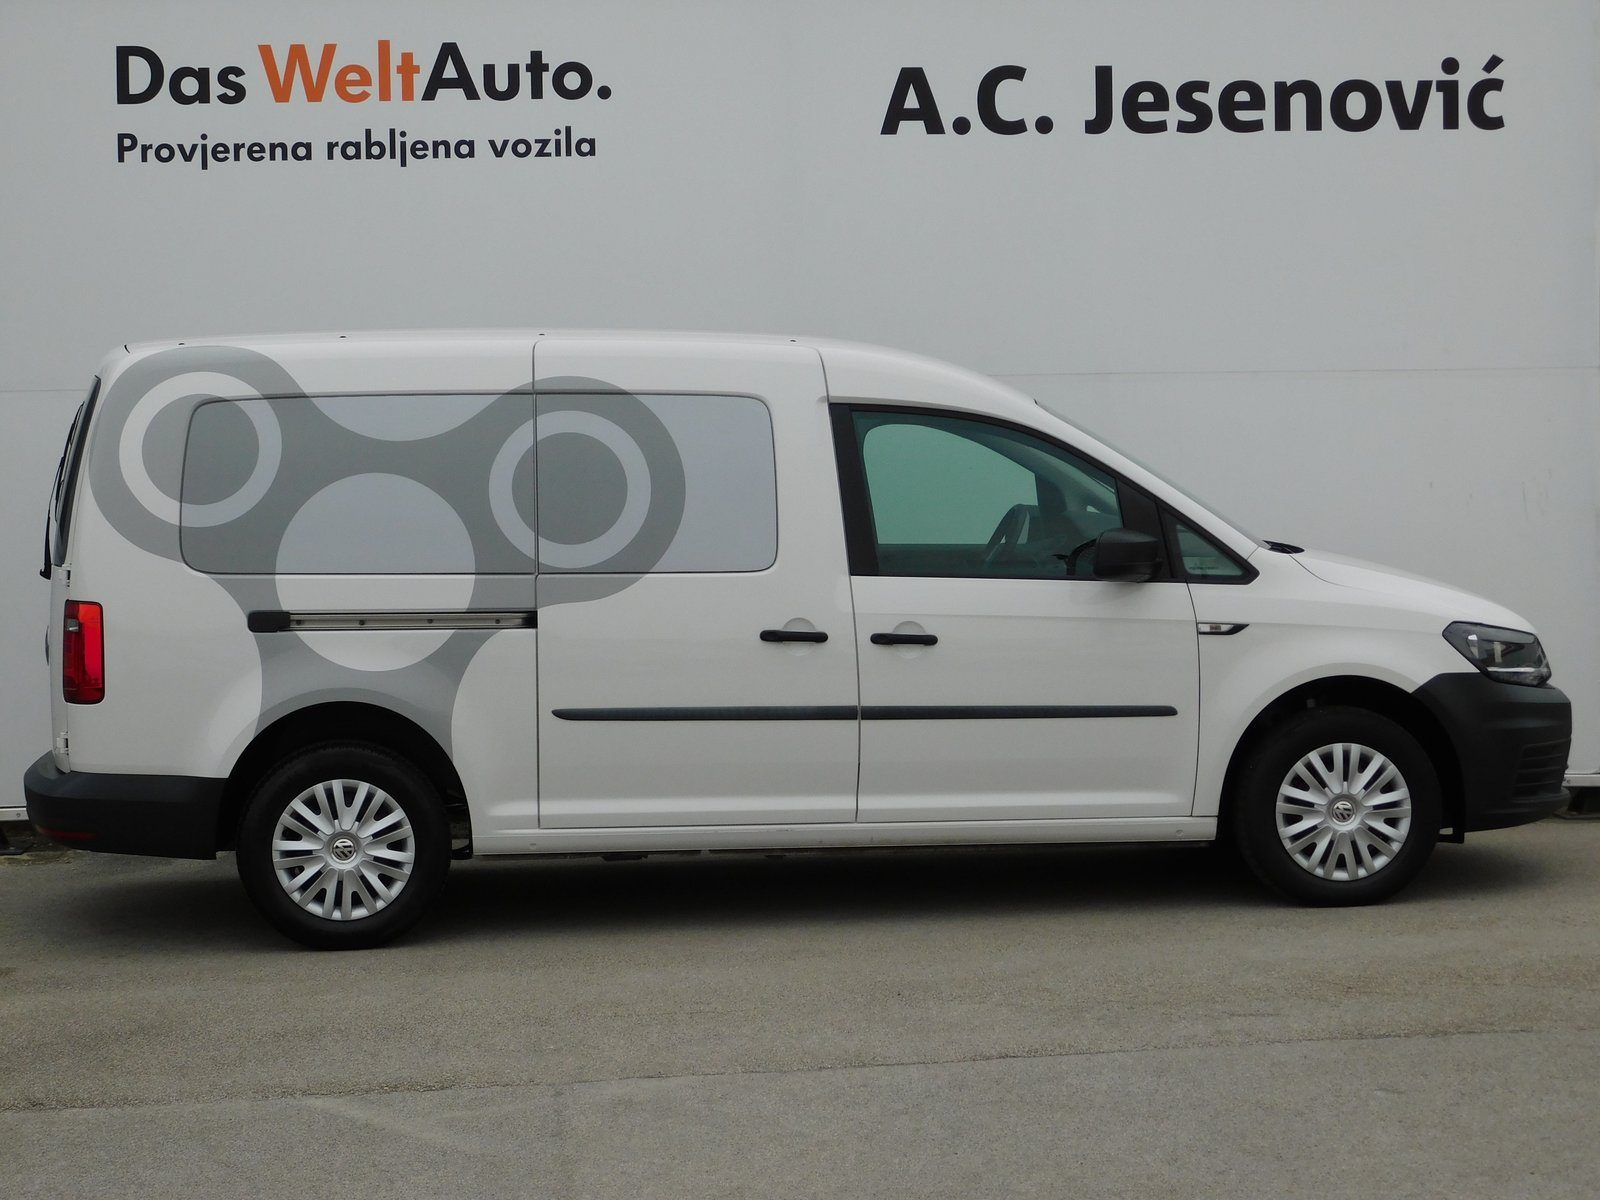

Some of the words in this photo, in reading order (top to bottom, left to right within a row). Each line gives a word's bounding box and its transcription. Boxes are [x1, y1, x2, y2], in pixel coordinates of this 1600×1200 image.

[115, 45, 247, 106] Das
[257, 39, 612, 105] WeltAuto.
[879, 64, 1054, 136] A.C.
[1085, 53, 1506, 135] Jesenović
[115, 132, 313, 171] Provjerena
[326, 128, 476, 168] rabljena
[487, 125, 597, 160] vozila
